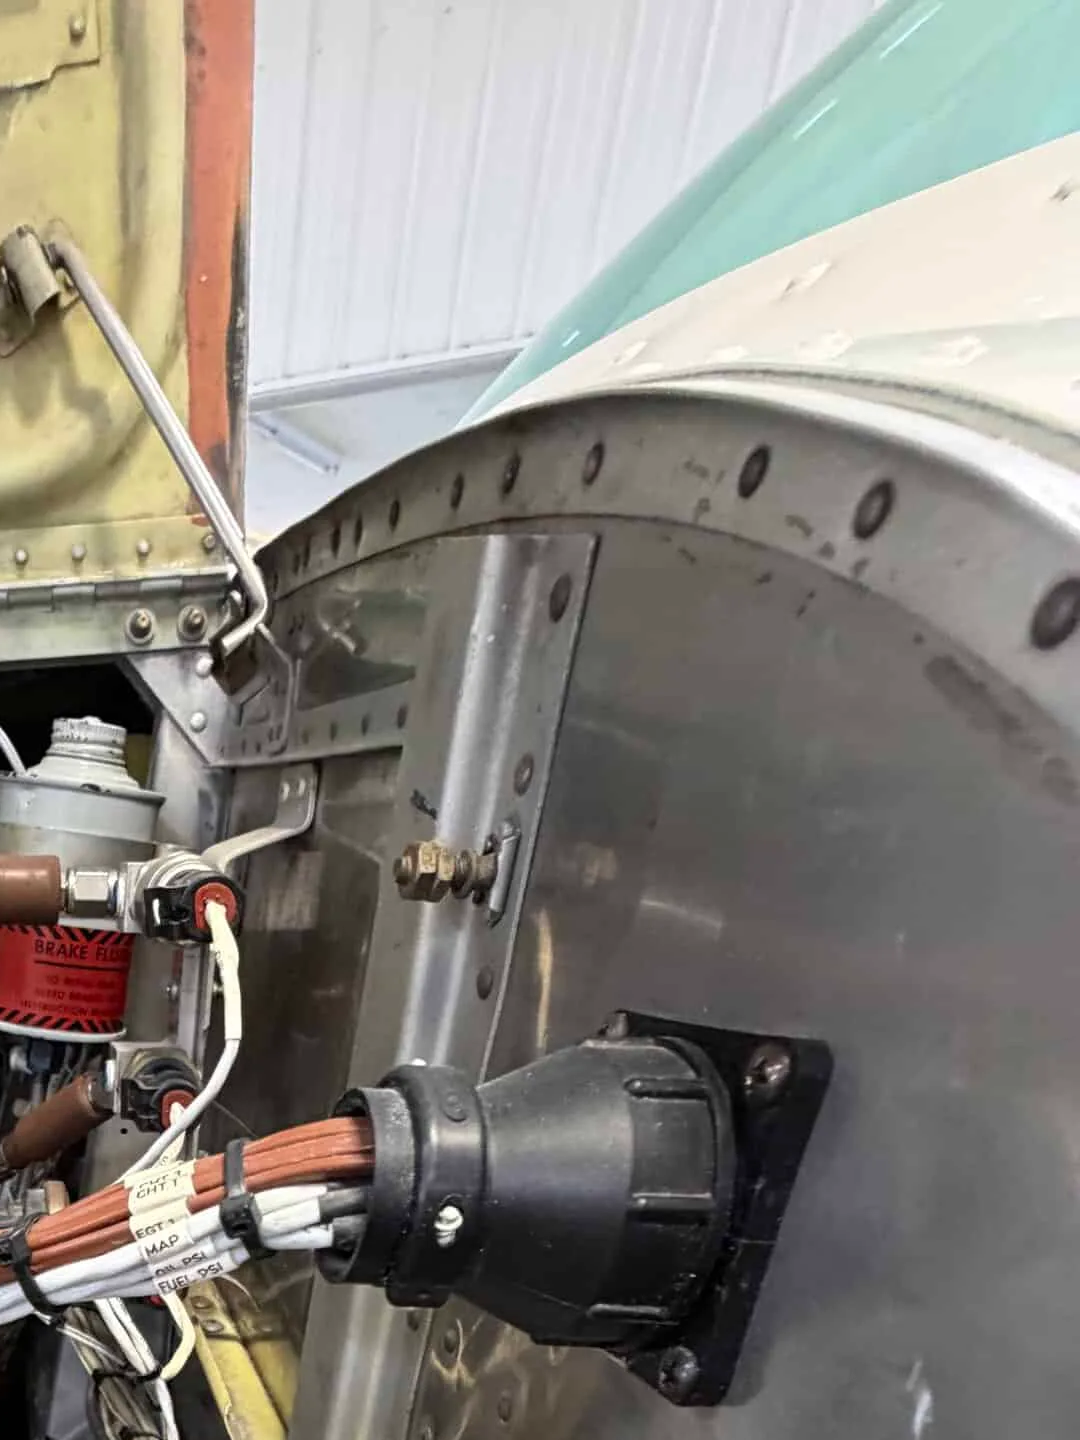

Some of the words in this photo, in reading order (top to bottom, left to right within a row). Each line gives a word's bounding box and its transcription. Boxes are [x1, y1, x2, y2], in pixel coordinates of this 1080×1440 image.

[34, 939, 89, 960] BRAKE
[136, 1181, 167, 1199] CHT
[135, 1221, 164, 1239] EGT
[145, 1233, 179, 1258] MAP
[155, 1263, 177, 1276] OIL
[181, 1250, 208, 1266] PSI
[158, 1274, 188, 1295] FUEL
[197, 1261, 224, 1279] PSI
